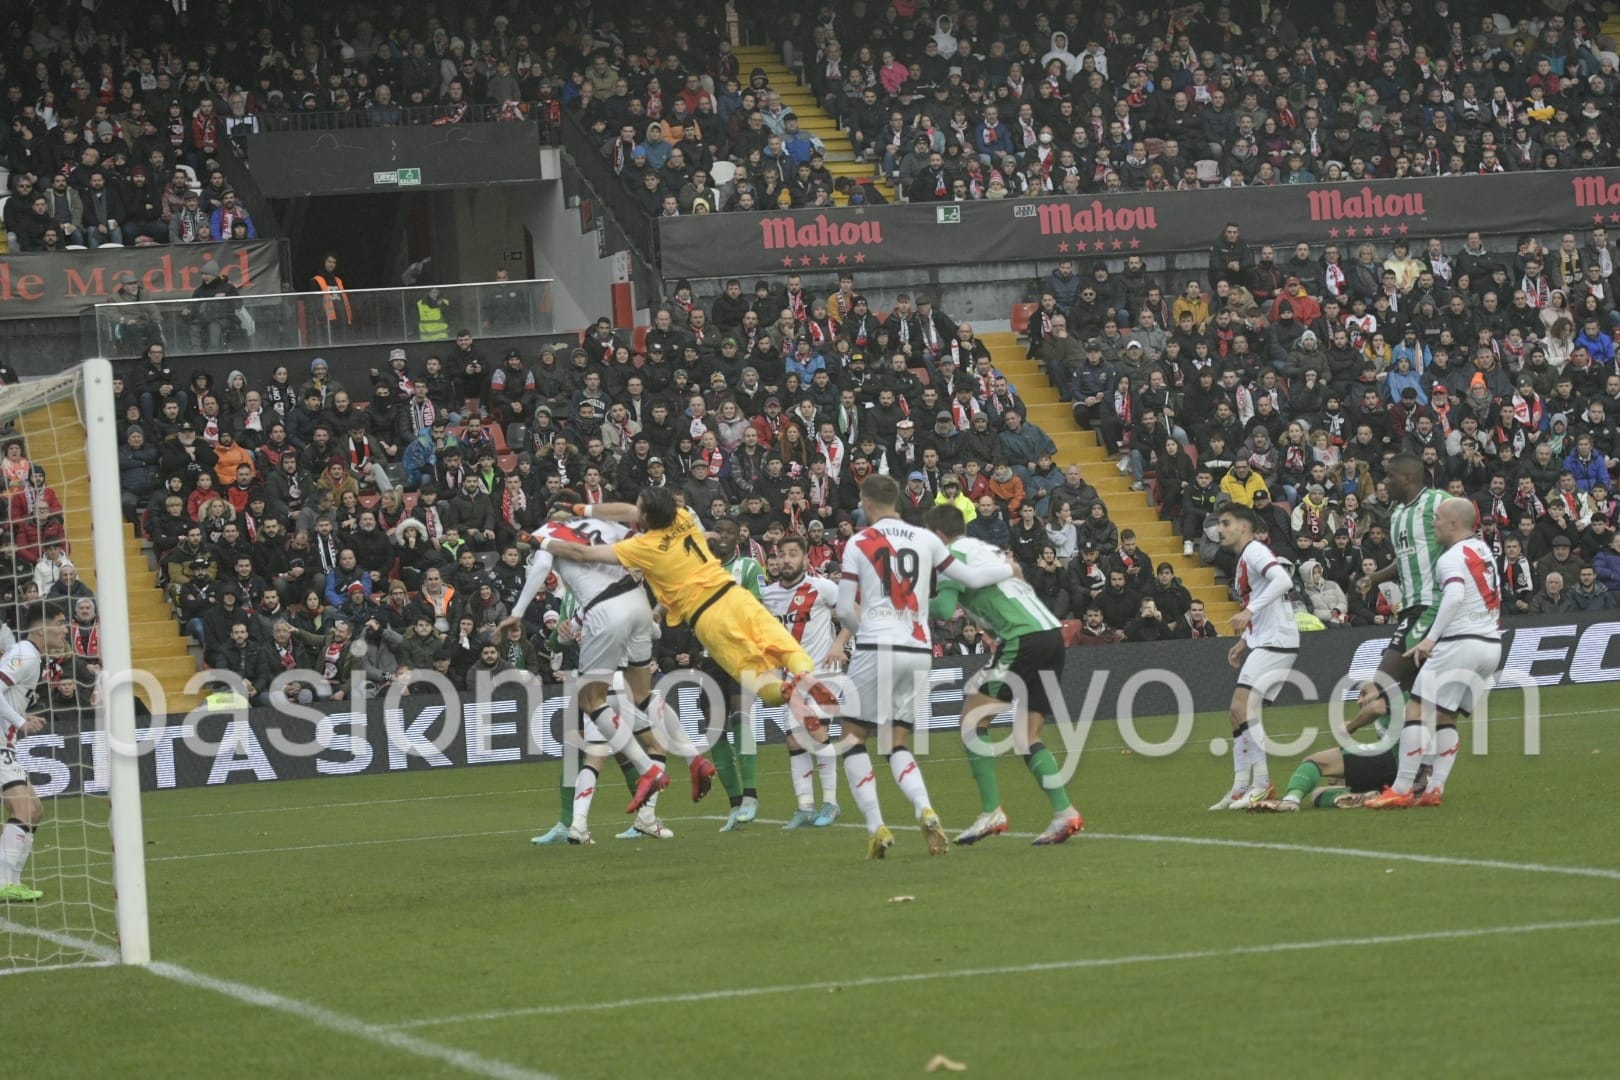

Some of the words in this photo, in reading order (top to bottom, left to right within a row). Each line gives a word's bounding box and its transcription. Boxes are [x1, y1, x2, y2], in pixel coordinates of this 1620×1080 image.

[1036, 200, 1158, 235] Mahou
[1306, 186, 1426, 221] Mahou
[759, 214, 884, 249] Mahou
[683, 534, 708, 564] 1
[874, 547, 920, 598] 19
